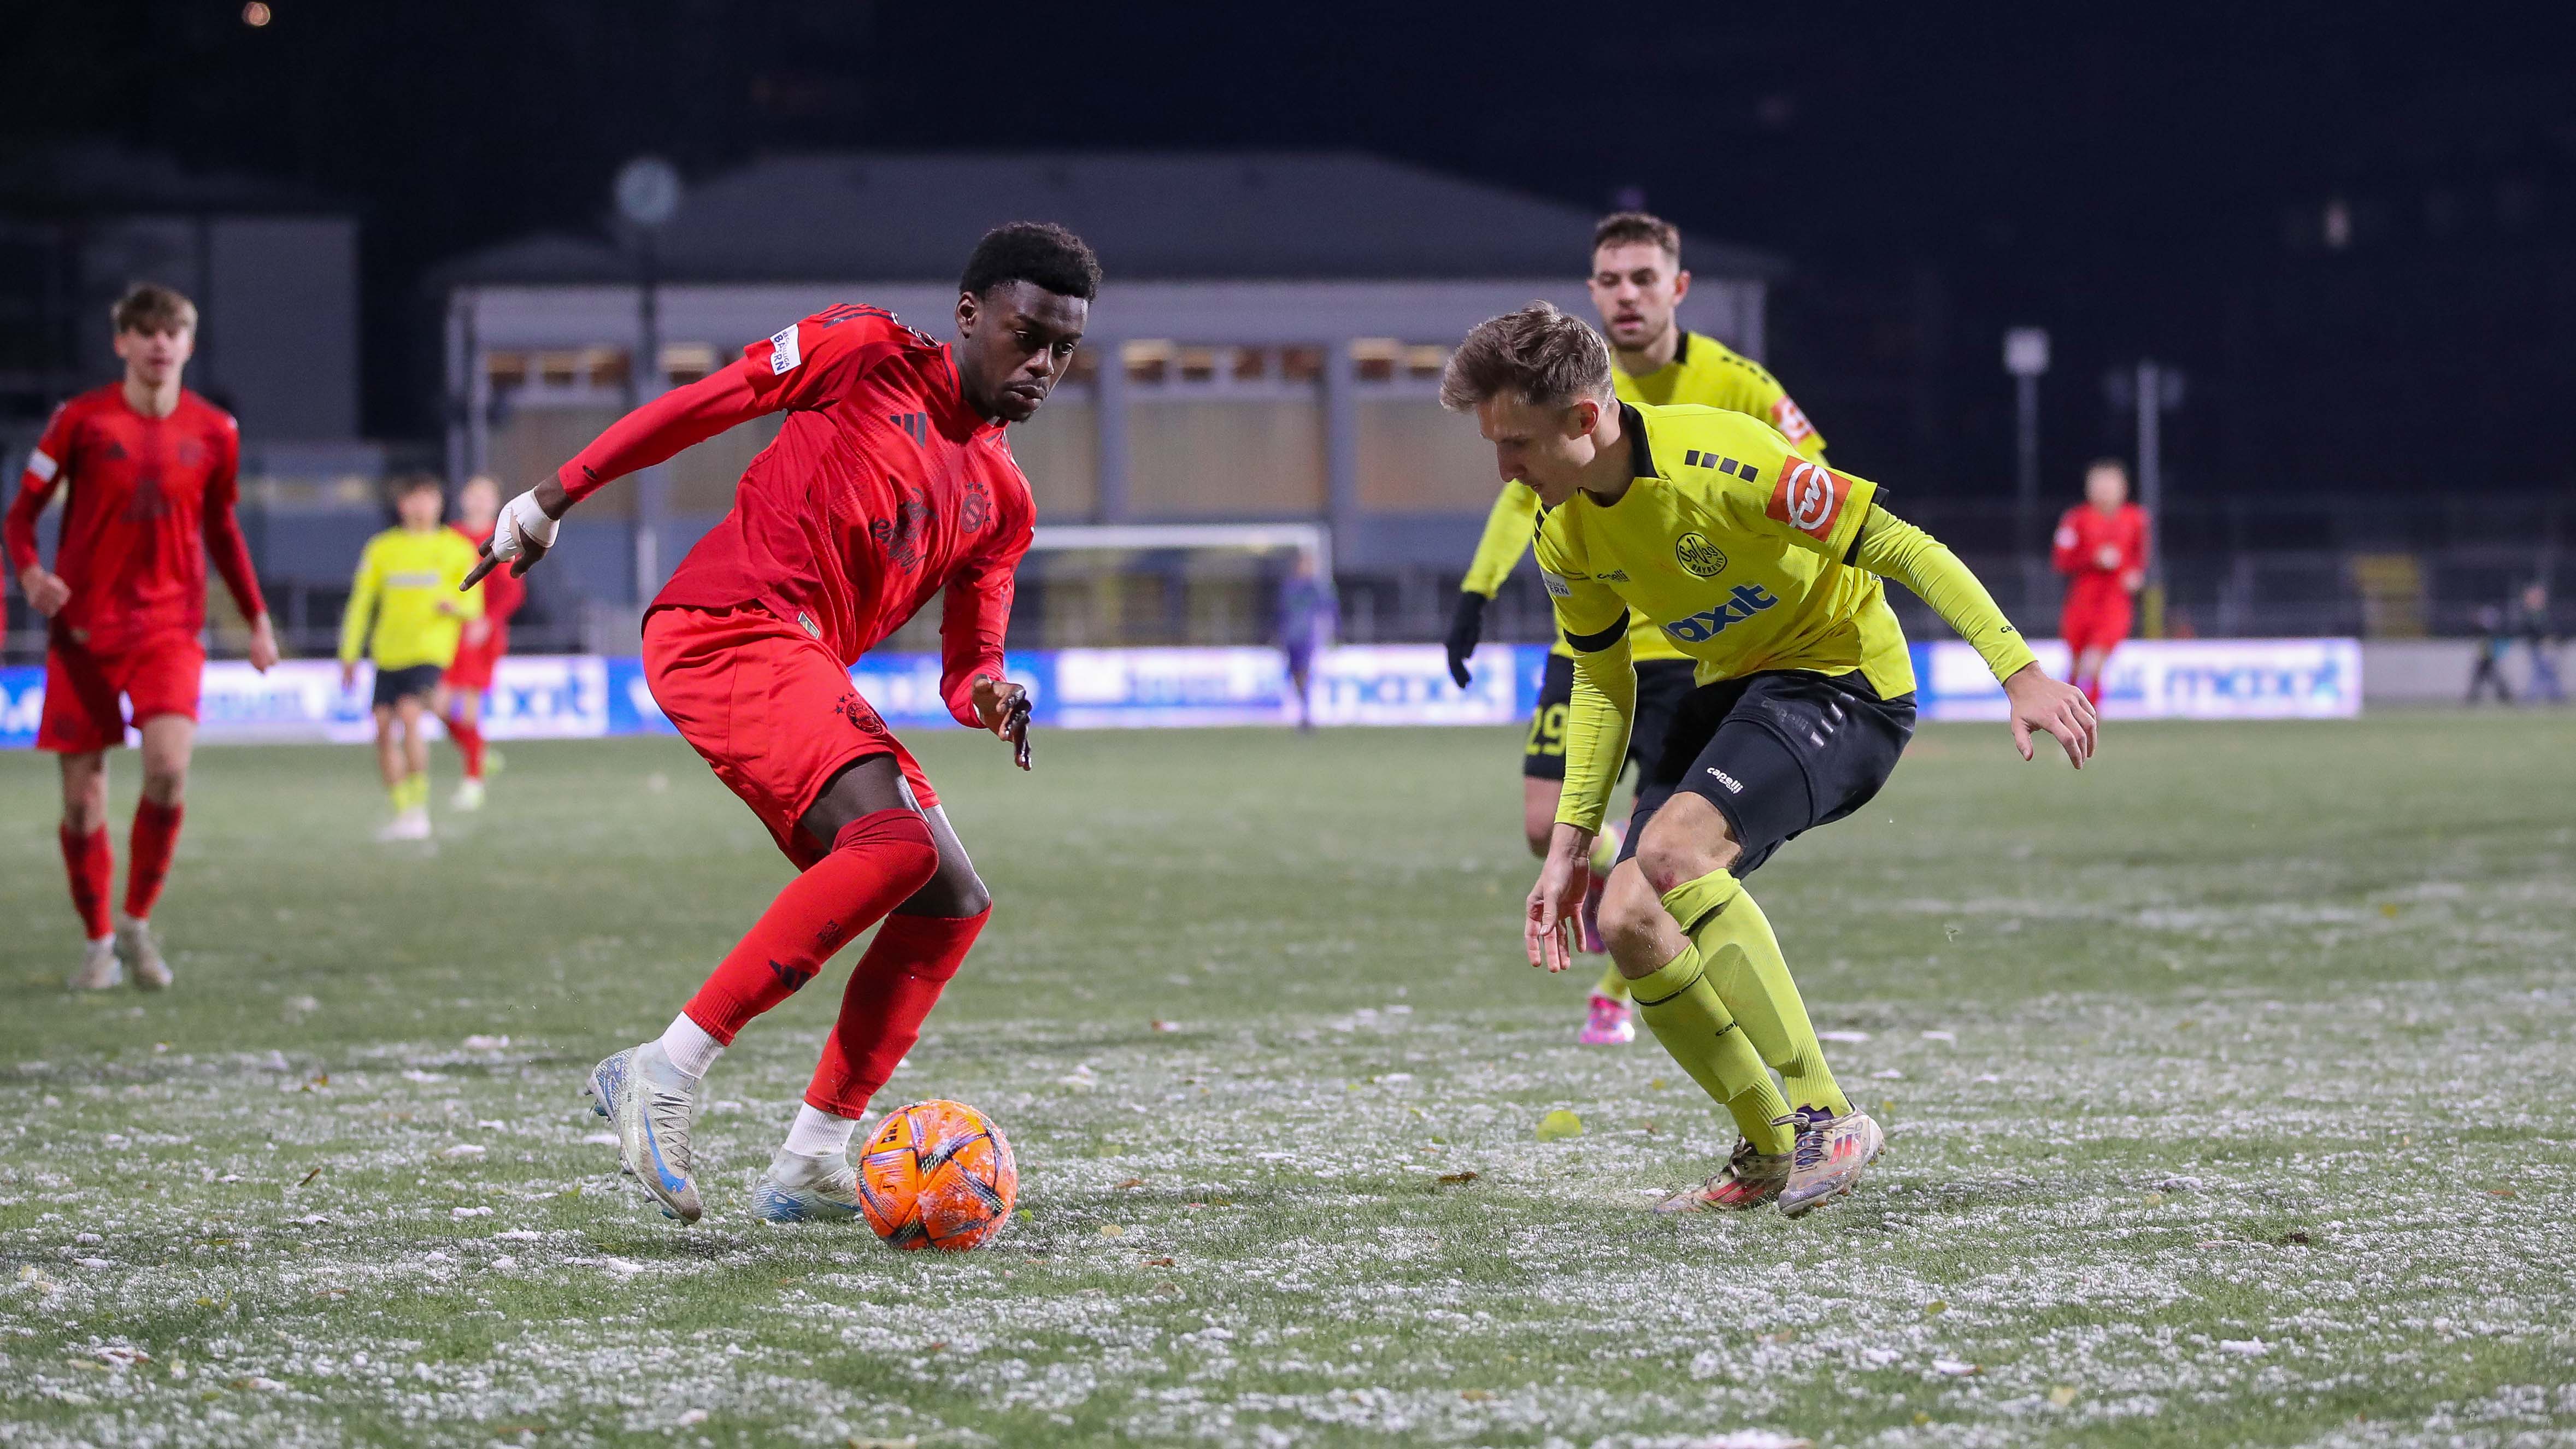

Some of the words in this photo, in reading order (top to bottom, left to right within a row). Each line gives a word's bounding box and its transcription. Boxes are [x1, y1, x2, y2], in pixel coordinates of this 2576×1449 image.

[1549, 585, 1569, 595] ERN
[1658, 583, 1779, 643] axit
[1525, 703, 1569, 756] 29
[1707, 767, 1744, 794] capelli
